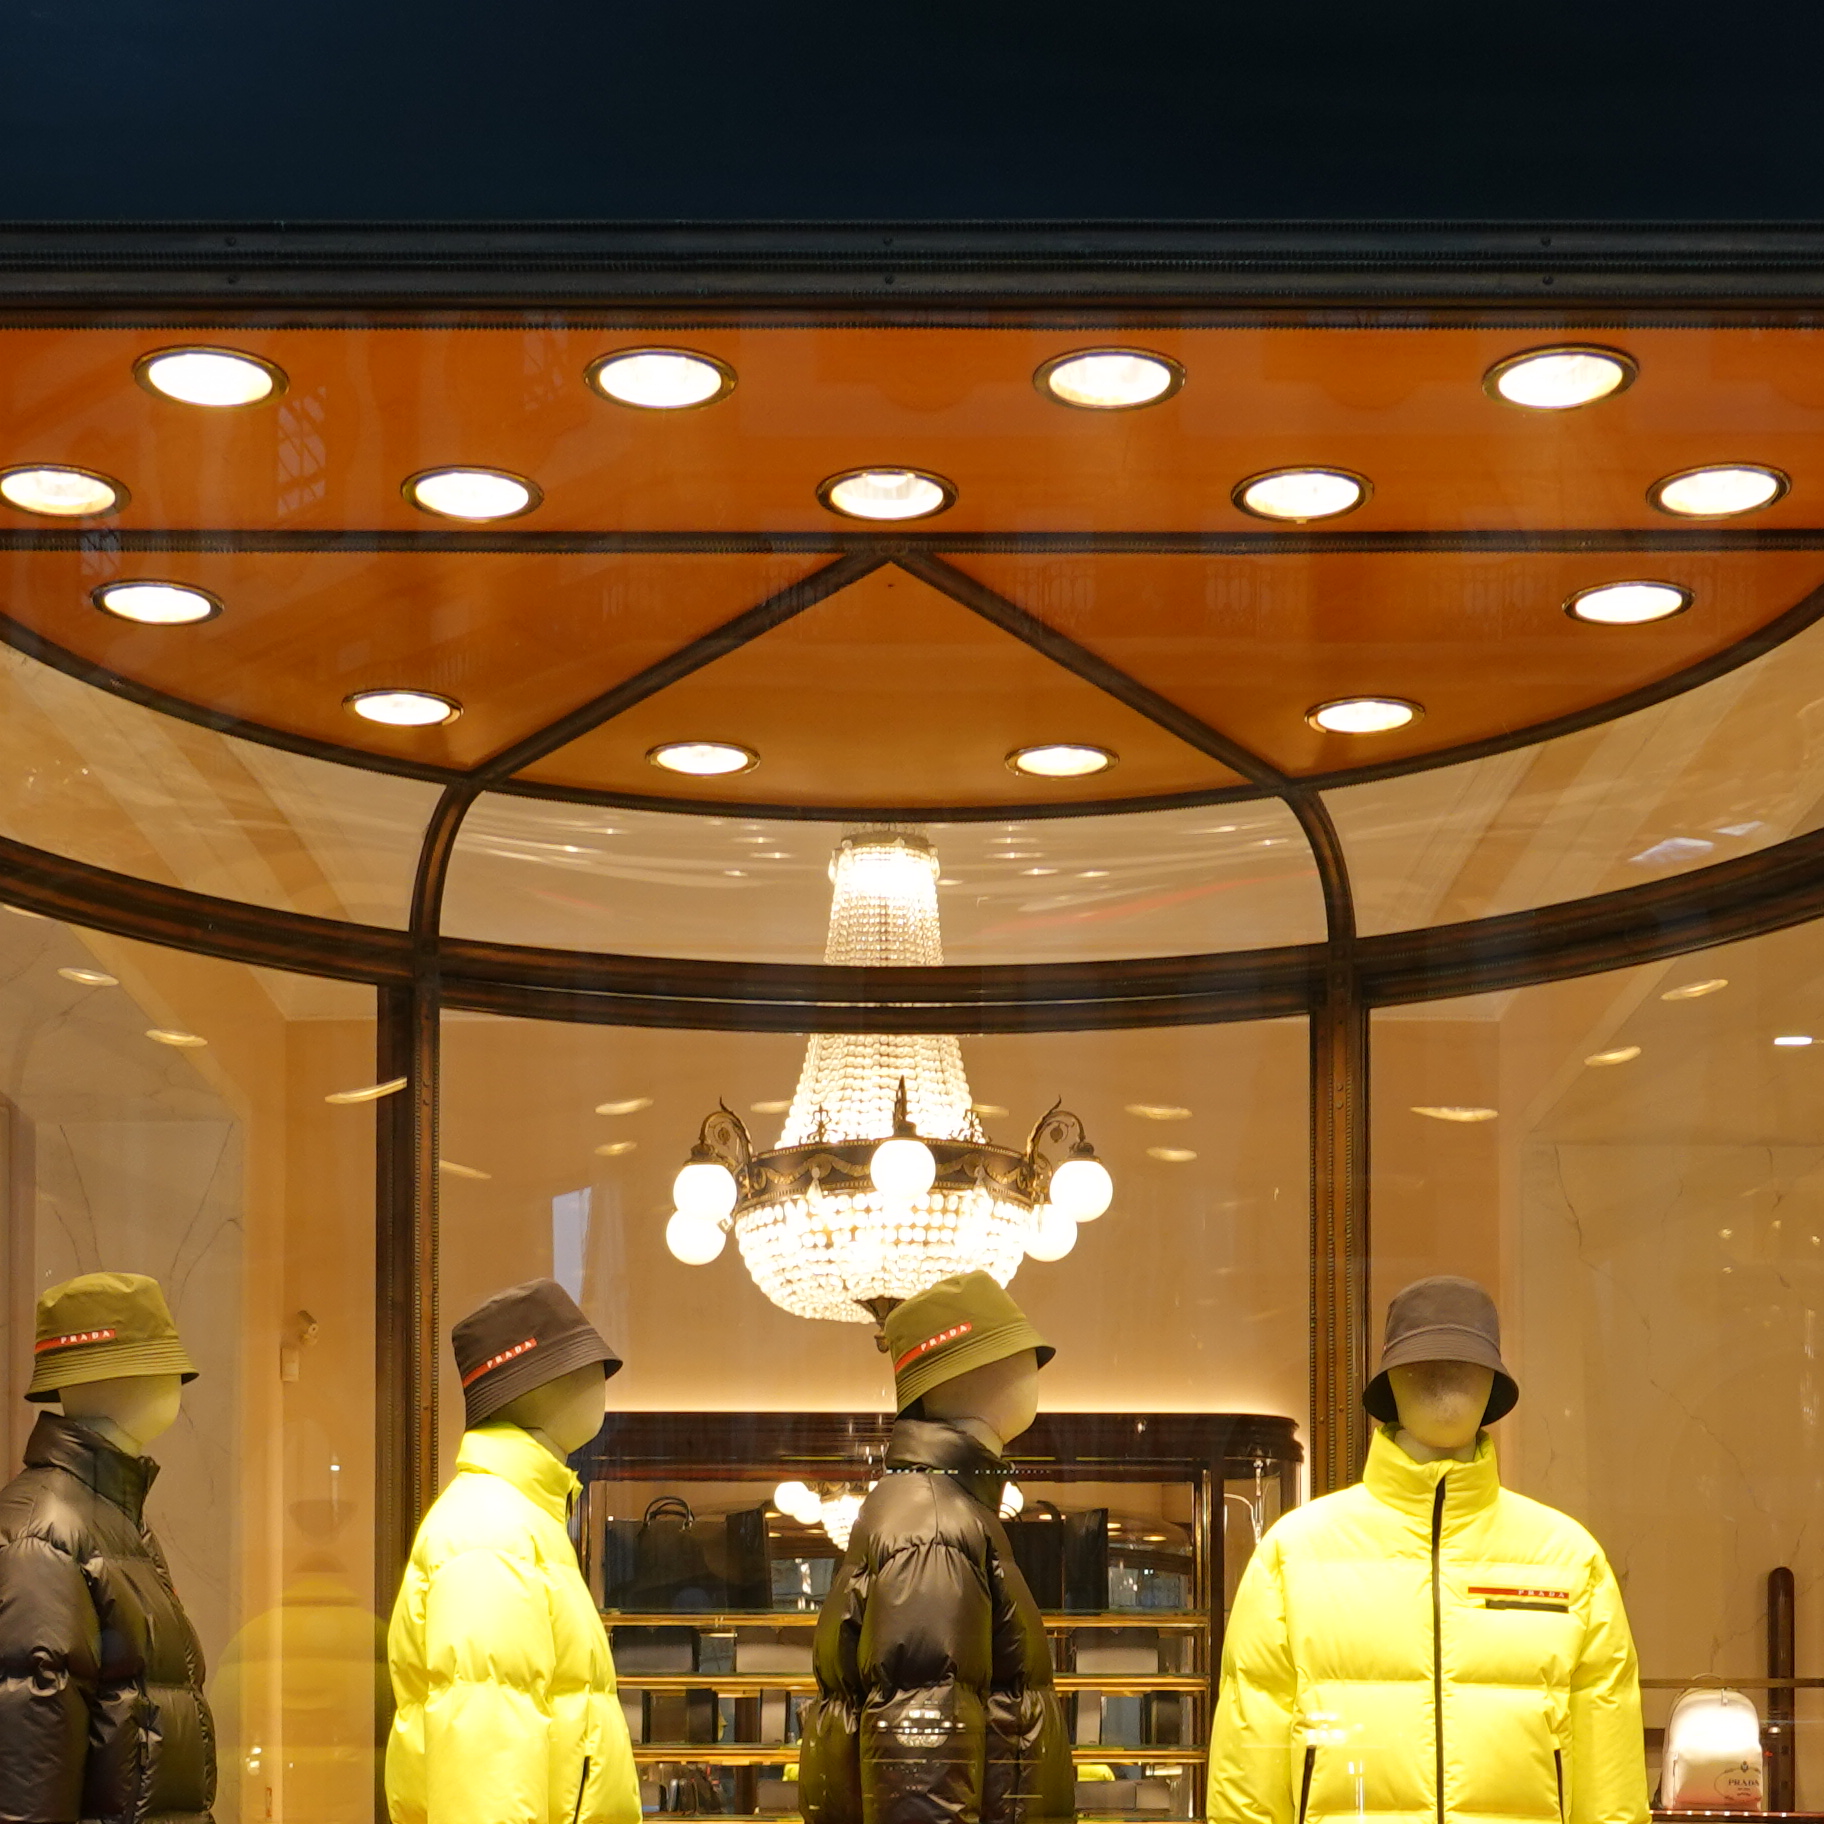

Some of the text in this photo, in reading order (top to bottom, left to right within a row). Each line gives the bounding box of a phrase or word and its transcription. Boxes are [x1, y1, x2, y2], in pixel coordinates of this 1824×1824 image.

[60, 1330, 111, 1345] PRADA
[920, 1324, 968, 1351] PRADA
[486, 1341, 532, 1369] PRADA
